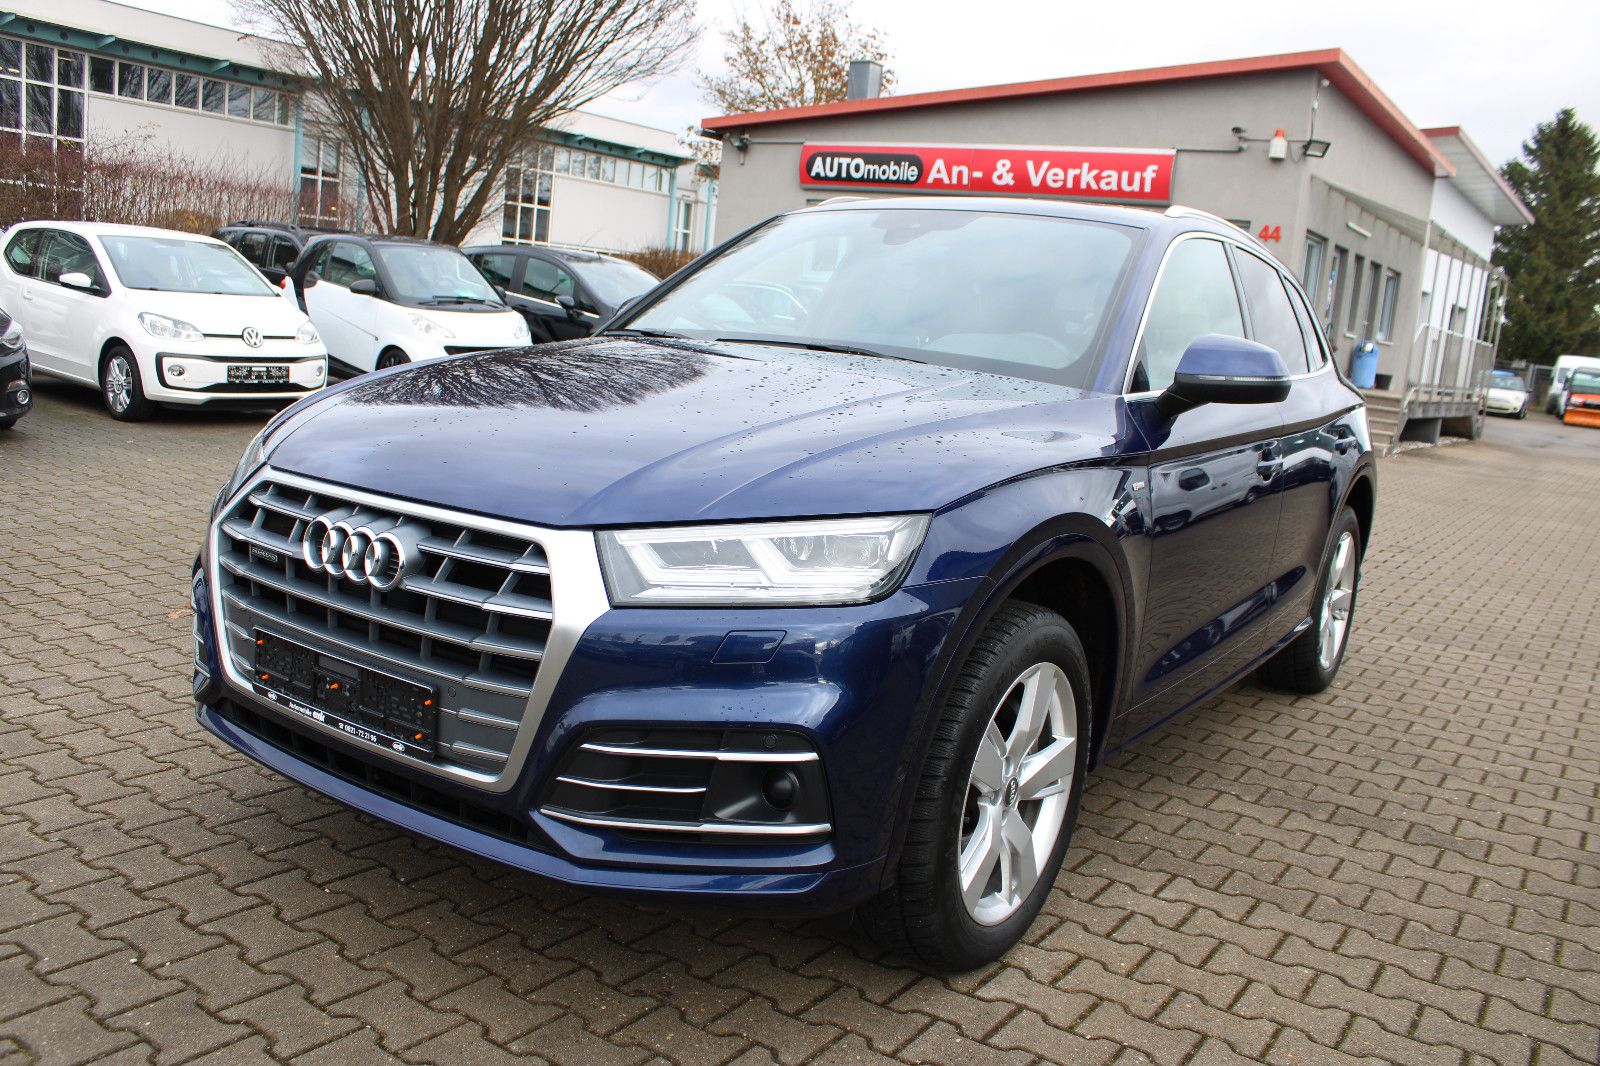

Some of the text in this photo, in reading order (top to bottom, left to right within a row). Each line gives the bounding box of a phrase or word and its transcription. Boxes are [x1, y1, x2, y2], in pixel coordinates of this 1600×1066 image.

[810, 156, 1159, 193] AUTOmobile An- & Verkauf
[1258, 224, 1281, 243] 44
